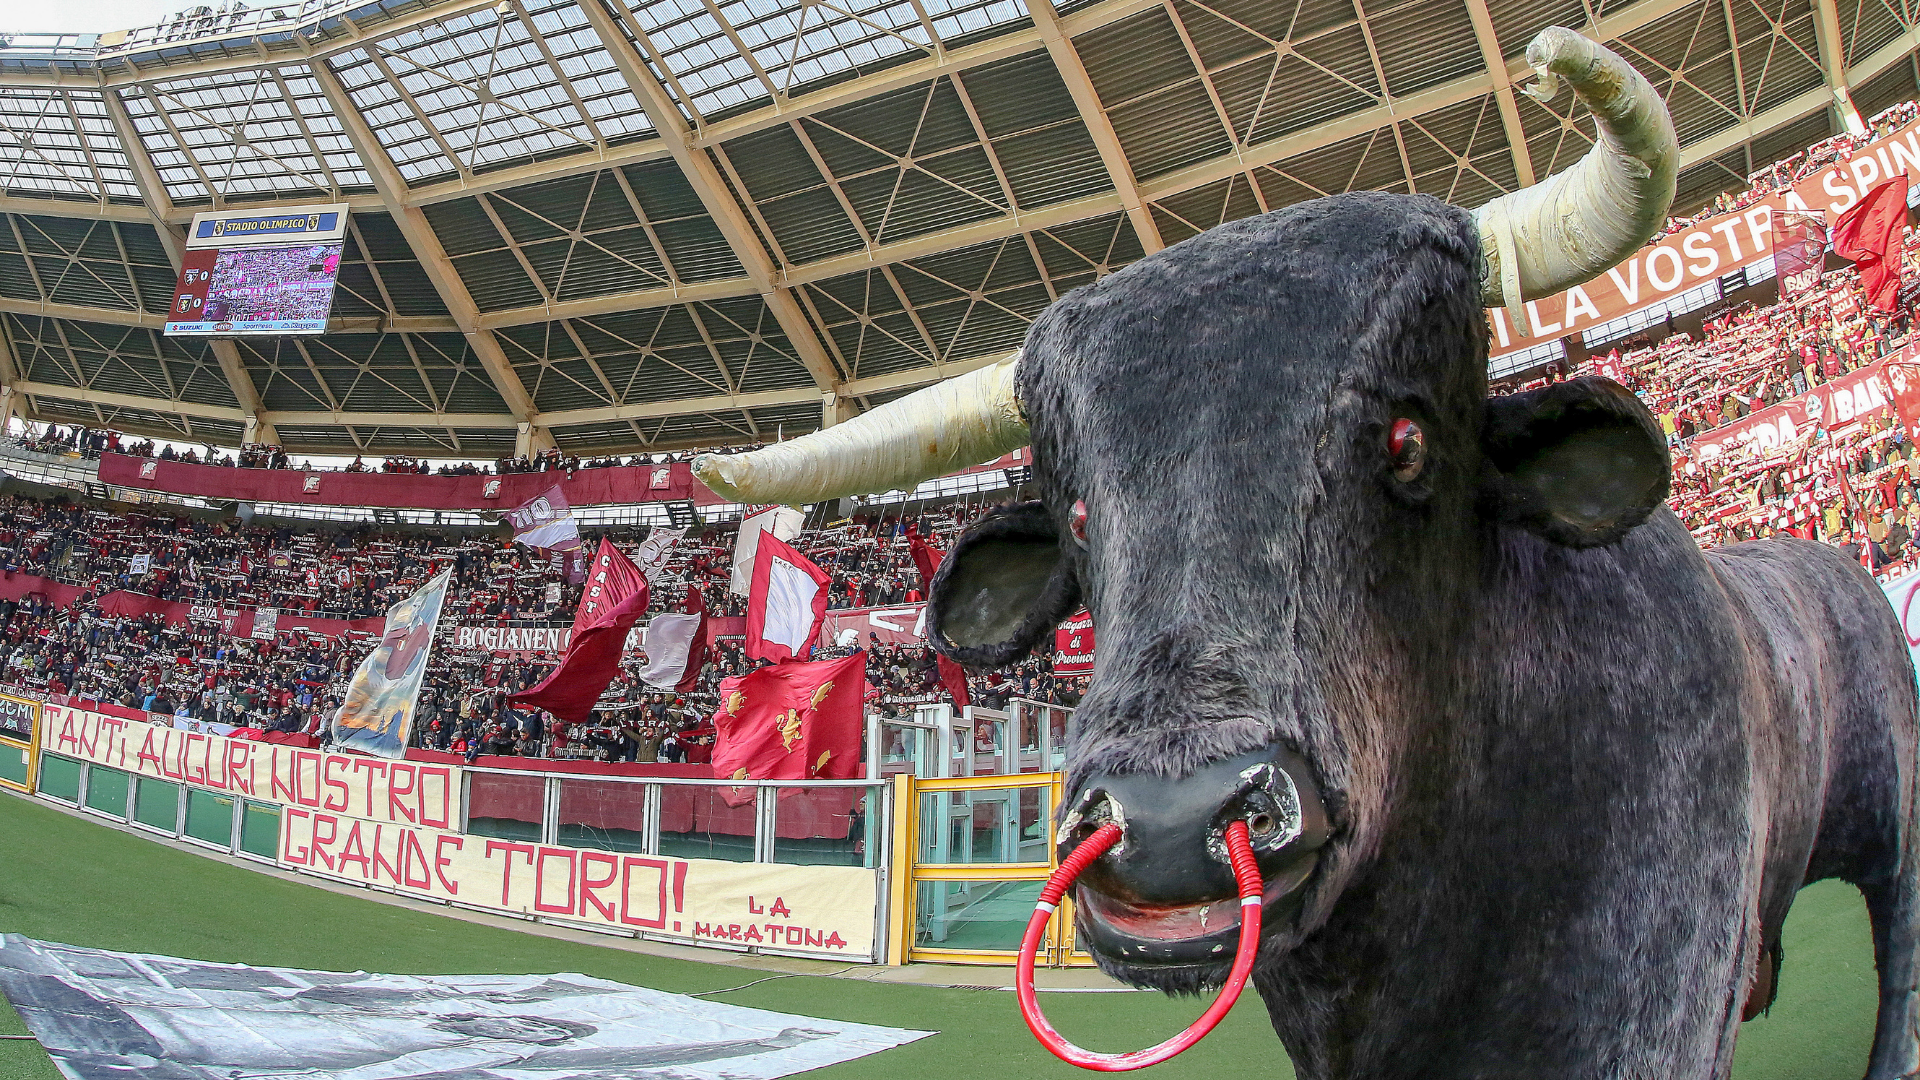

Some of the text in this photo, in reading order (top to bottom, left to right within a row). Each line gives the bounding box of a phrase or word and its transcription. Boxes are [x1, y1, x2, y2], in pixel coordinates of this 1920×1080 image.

[226, 218, 305, 232] STADIO OLIMPICO
[200, 271, 208, 281] 0
[193, 298, 201, 308] 0
[459, 626, 561, 651] BOGIANEN
[1070, 635, 1082, 648] di
[271, 747, 451, 829] NOSTRO
[284, 807, 689, 932] GRANDE TORO!
[748, 895, 791, 918] LA
[695, 921, 848, 949] MARATONA
